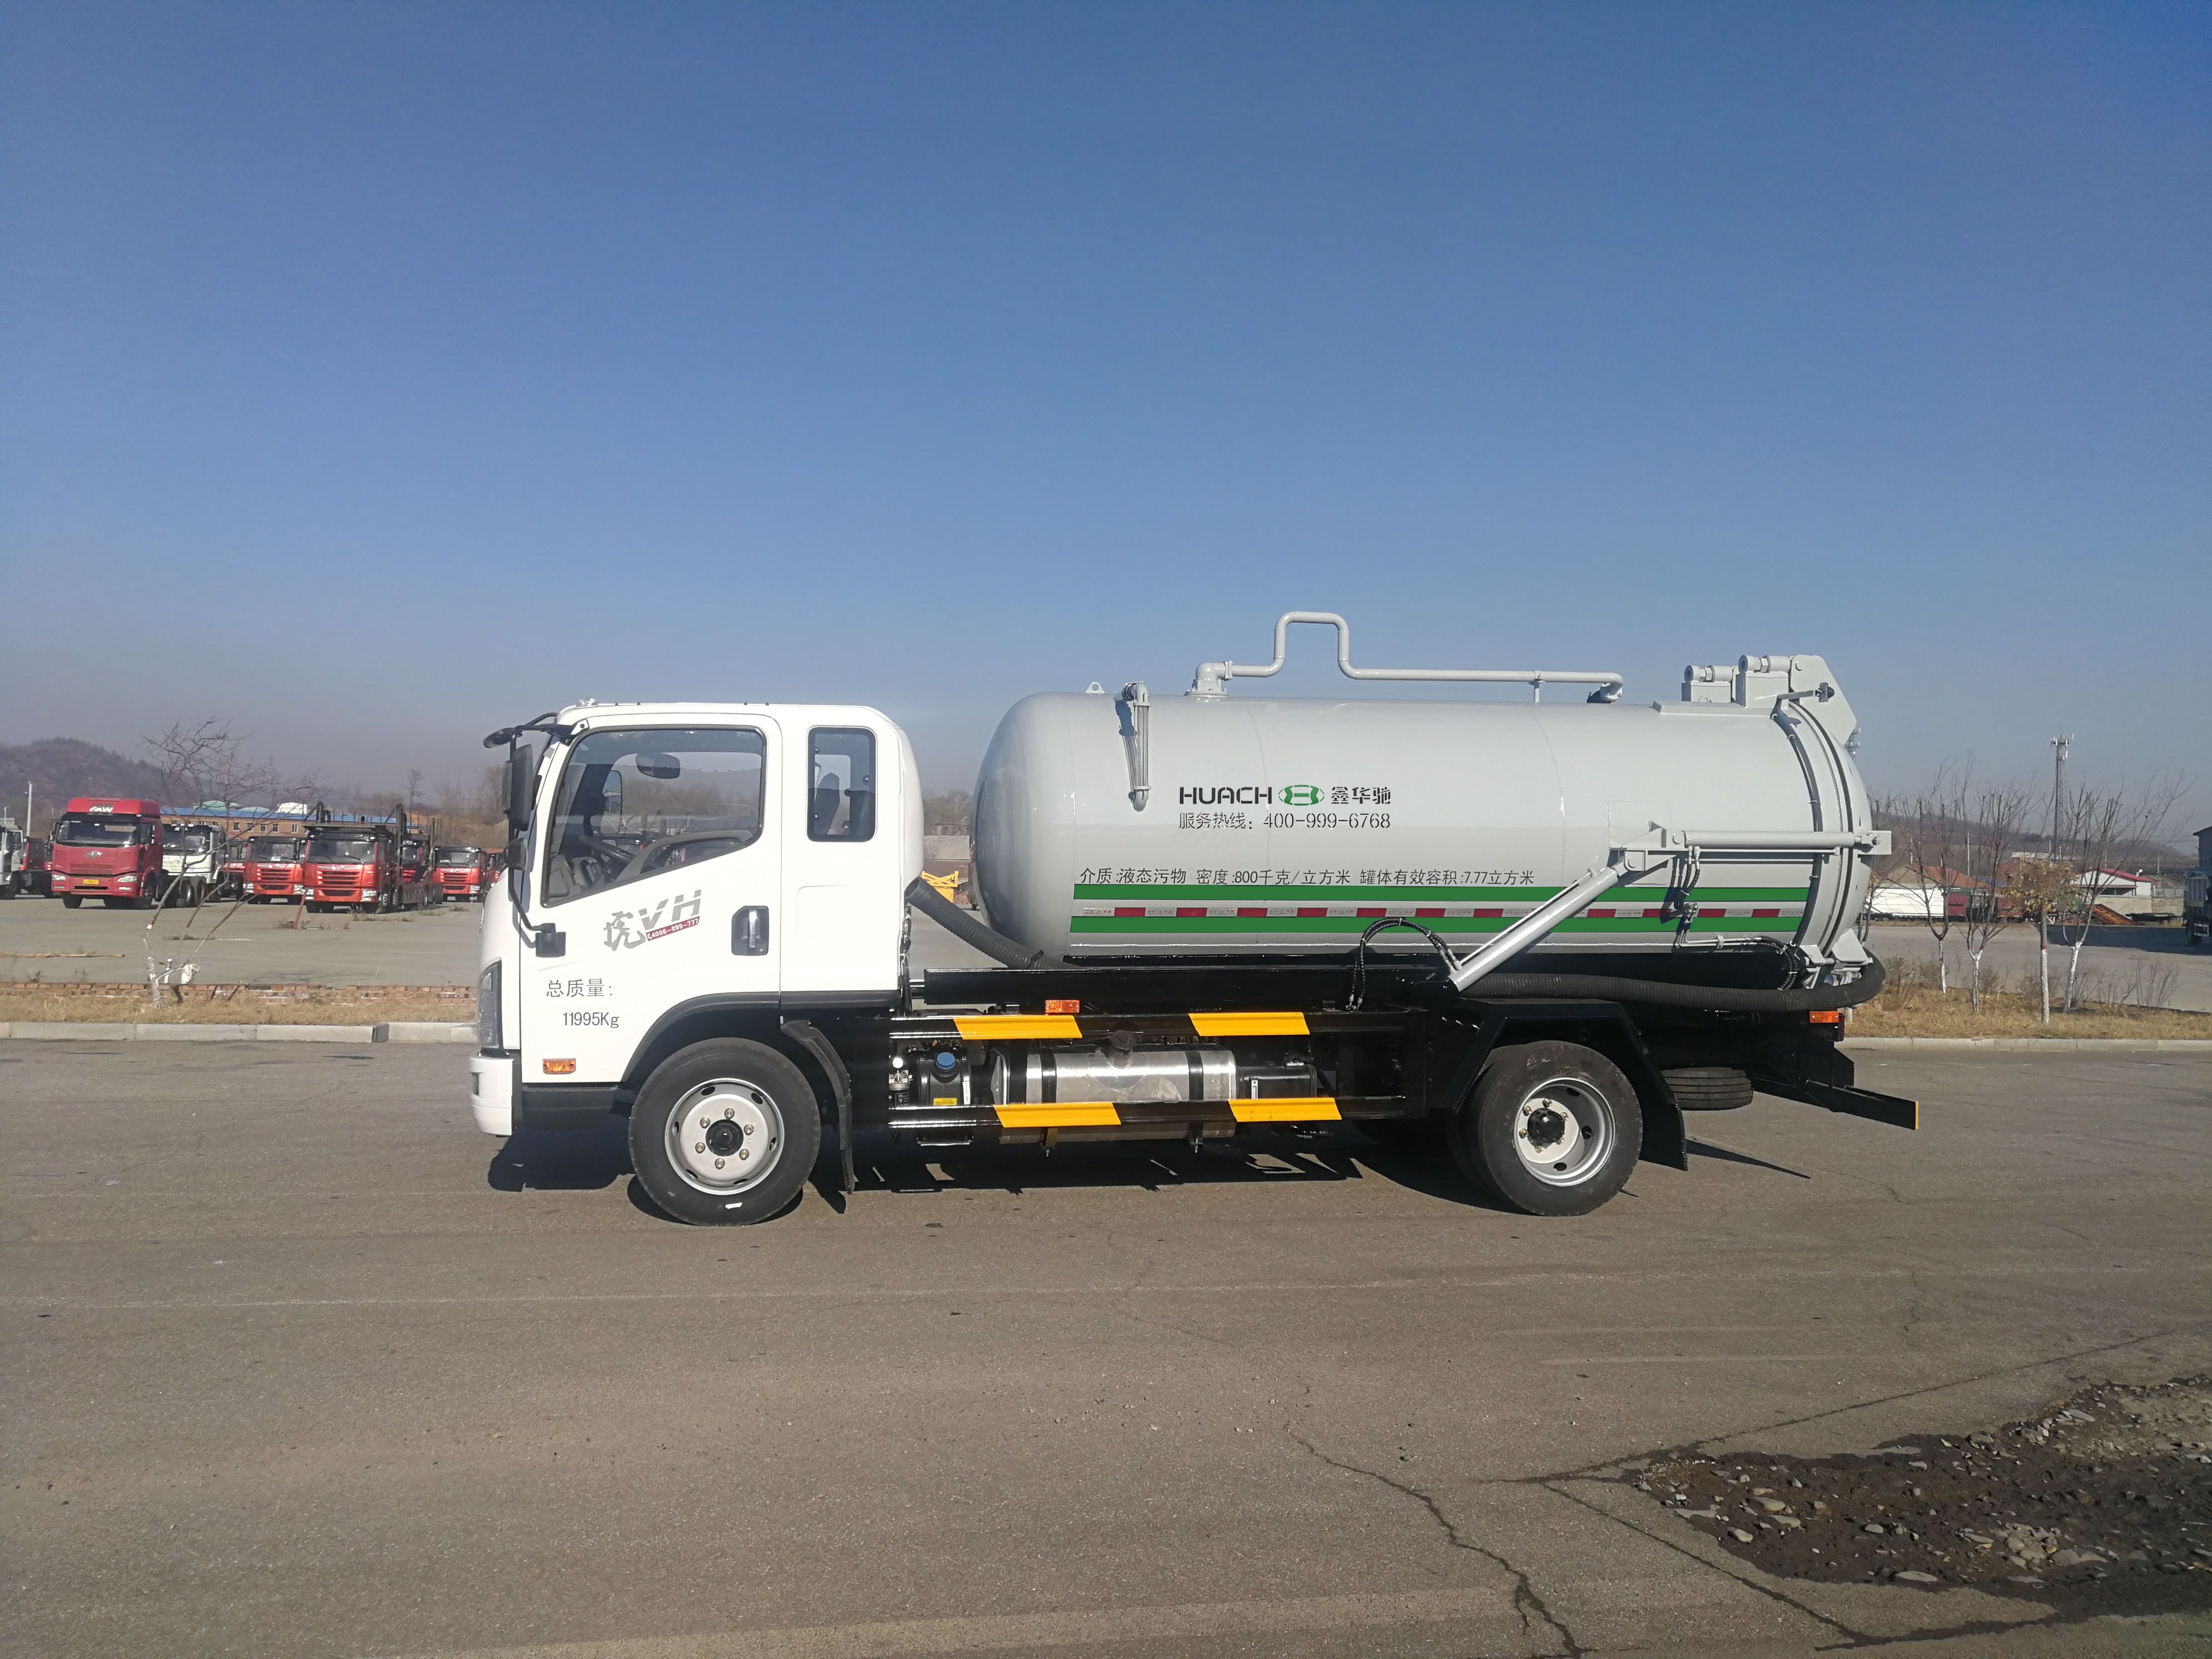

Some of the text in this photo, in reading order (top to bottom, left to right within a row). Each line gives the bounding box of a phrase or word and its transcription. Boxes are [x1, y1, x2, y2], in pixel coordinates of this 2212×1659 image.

[1179, 786, 1391, 804] HUACH 鑫华驰
[1263, 813, 1391, 829] 400-999-6768
[562, 1012, 619, 1029] 11995Kg
